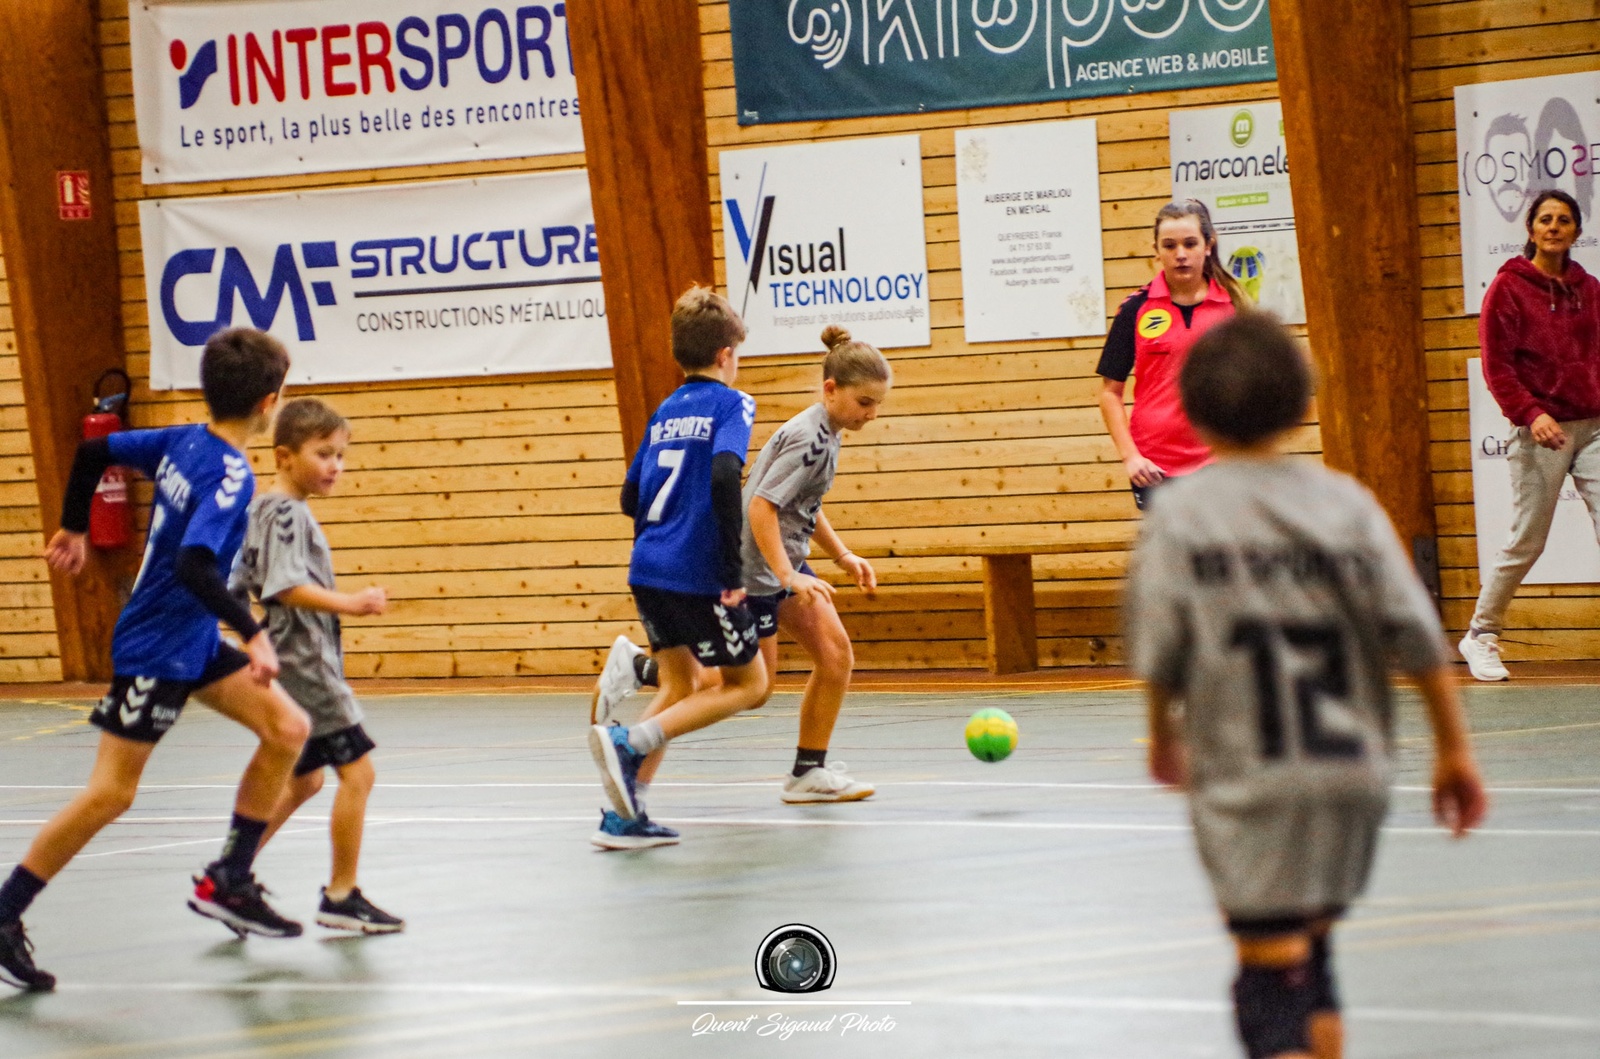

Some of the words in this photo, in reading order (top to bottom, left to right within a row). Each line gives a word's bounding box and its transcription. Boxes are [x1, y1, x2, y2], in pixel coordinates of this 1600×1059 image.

[1076, 58, 1143, 82] AGENCE
[1146, 54, 1184, 75] WEB
[1187, 53, 1198, 71] &
[1202, 46, 1269, 70] MOBILE
[181, 126, 204, 147] Le
[214, 121, 273, 150] sport,
[282, 117, 299, 140] la
[310, 114, 351, 143] plus
[360, 107, 412, 133] belle
[421, 105, 455, 128] des
[466, 96, 580, 125] rencontres
[985, 192, 1021, 203] AUBERGE
[1024, 191, 1034, 200] DE
[1036, 188, 1072, 199] MARLIOU
[1006, 206, 1017, 216] EN
[1019, 204, 1051, 214] MEYGAL
[160, 240, 339, 346] CMF
[769, 273, 923, 308] TECHNOLOGY
[356, 305, 505, 333] CONSTRUCTIONS
[647, 449, 686, 522] 7
[1229, 615, 1363, 758] 12
